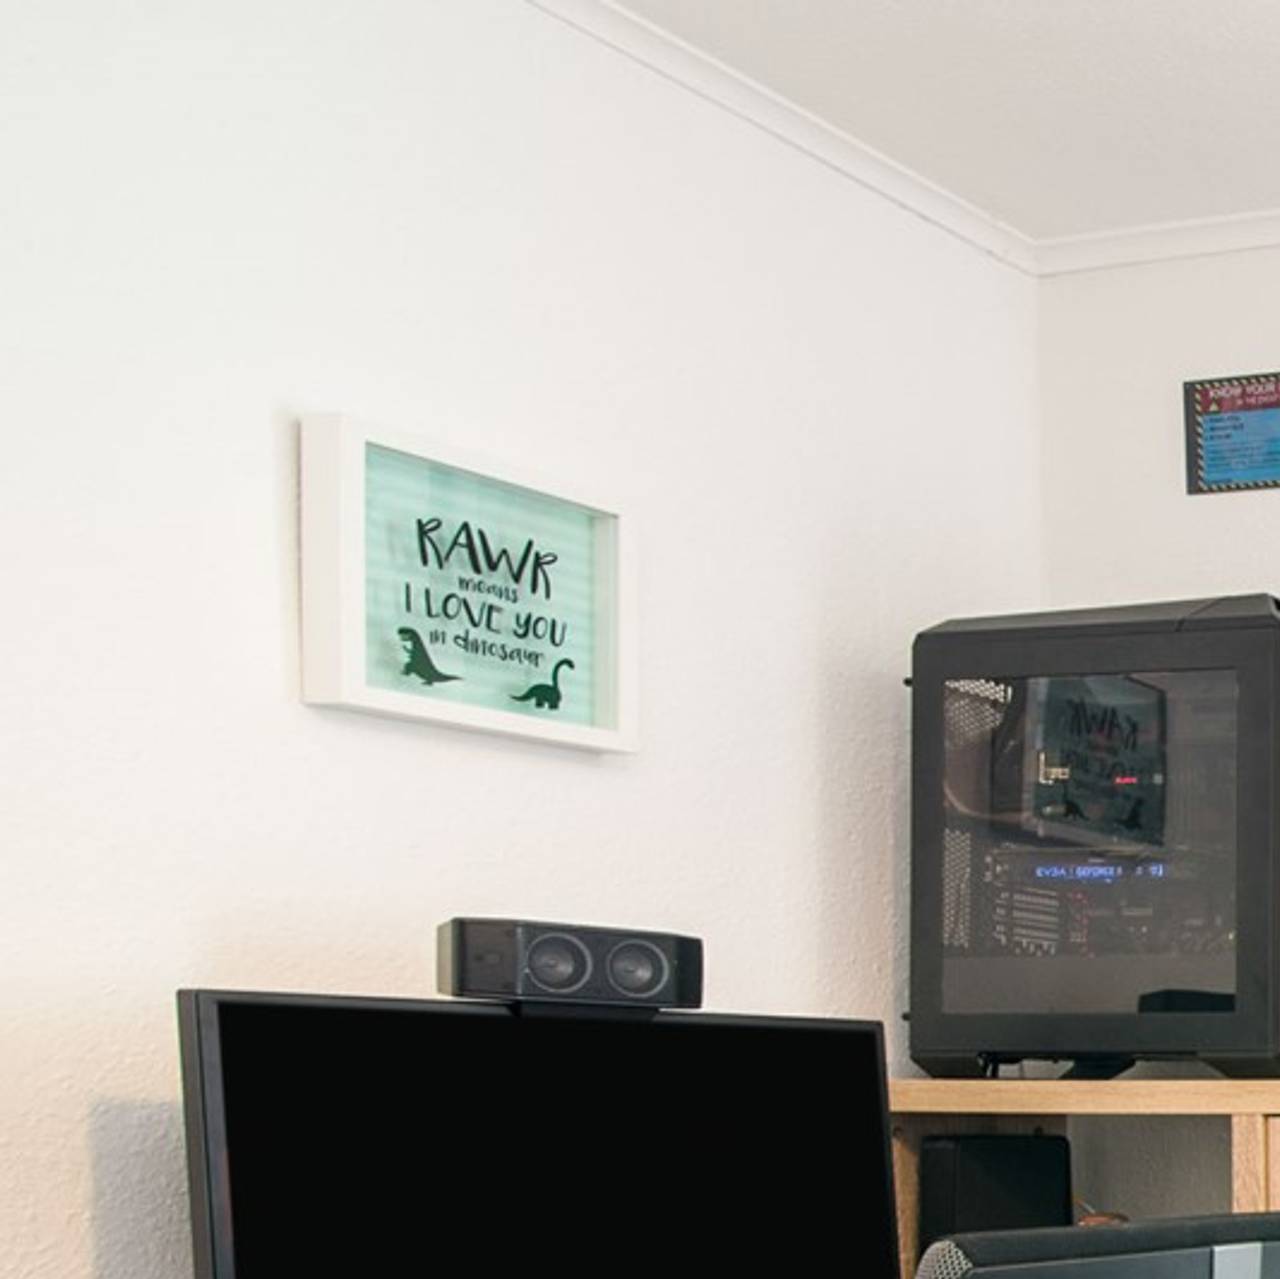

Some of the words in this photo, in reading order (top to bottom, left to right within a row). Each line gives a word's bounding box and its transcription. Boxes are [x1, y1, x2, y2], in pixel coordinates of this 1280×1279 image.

[416, 518, 559, 600] RAWR
[405, 582, 412, 613] I
[425, 588, 504, 634] LOVE
[458, 576, 519, 604] means
[429, 630, 447, 645] in
[453, 629, 544, 668] dinosaur
